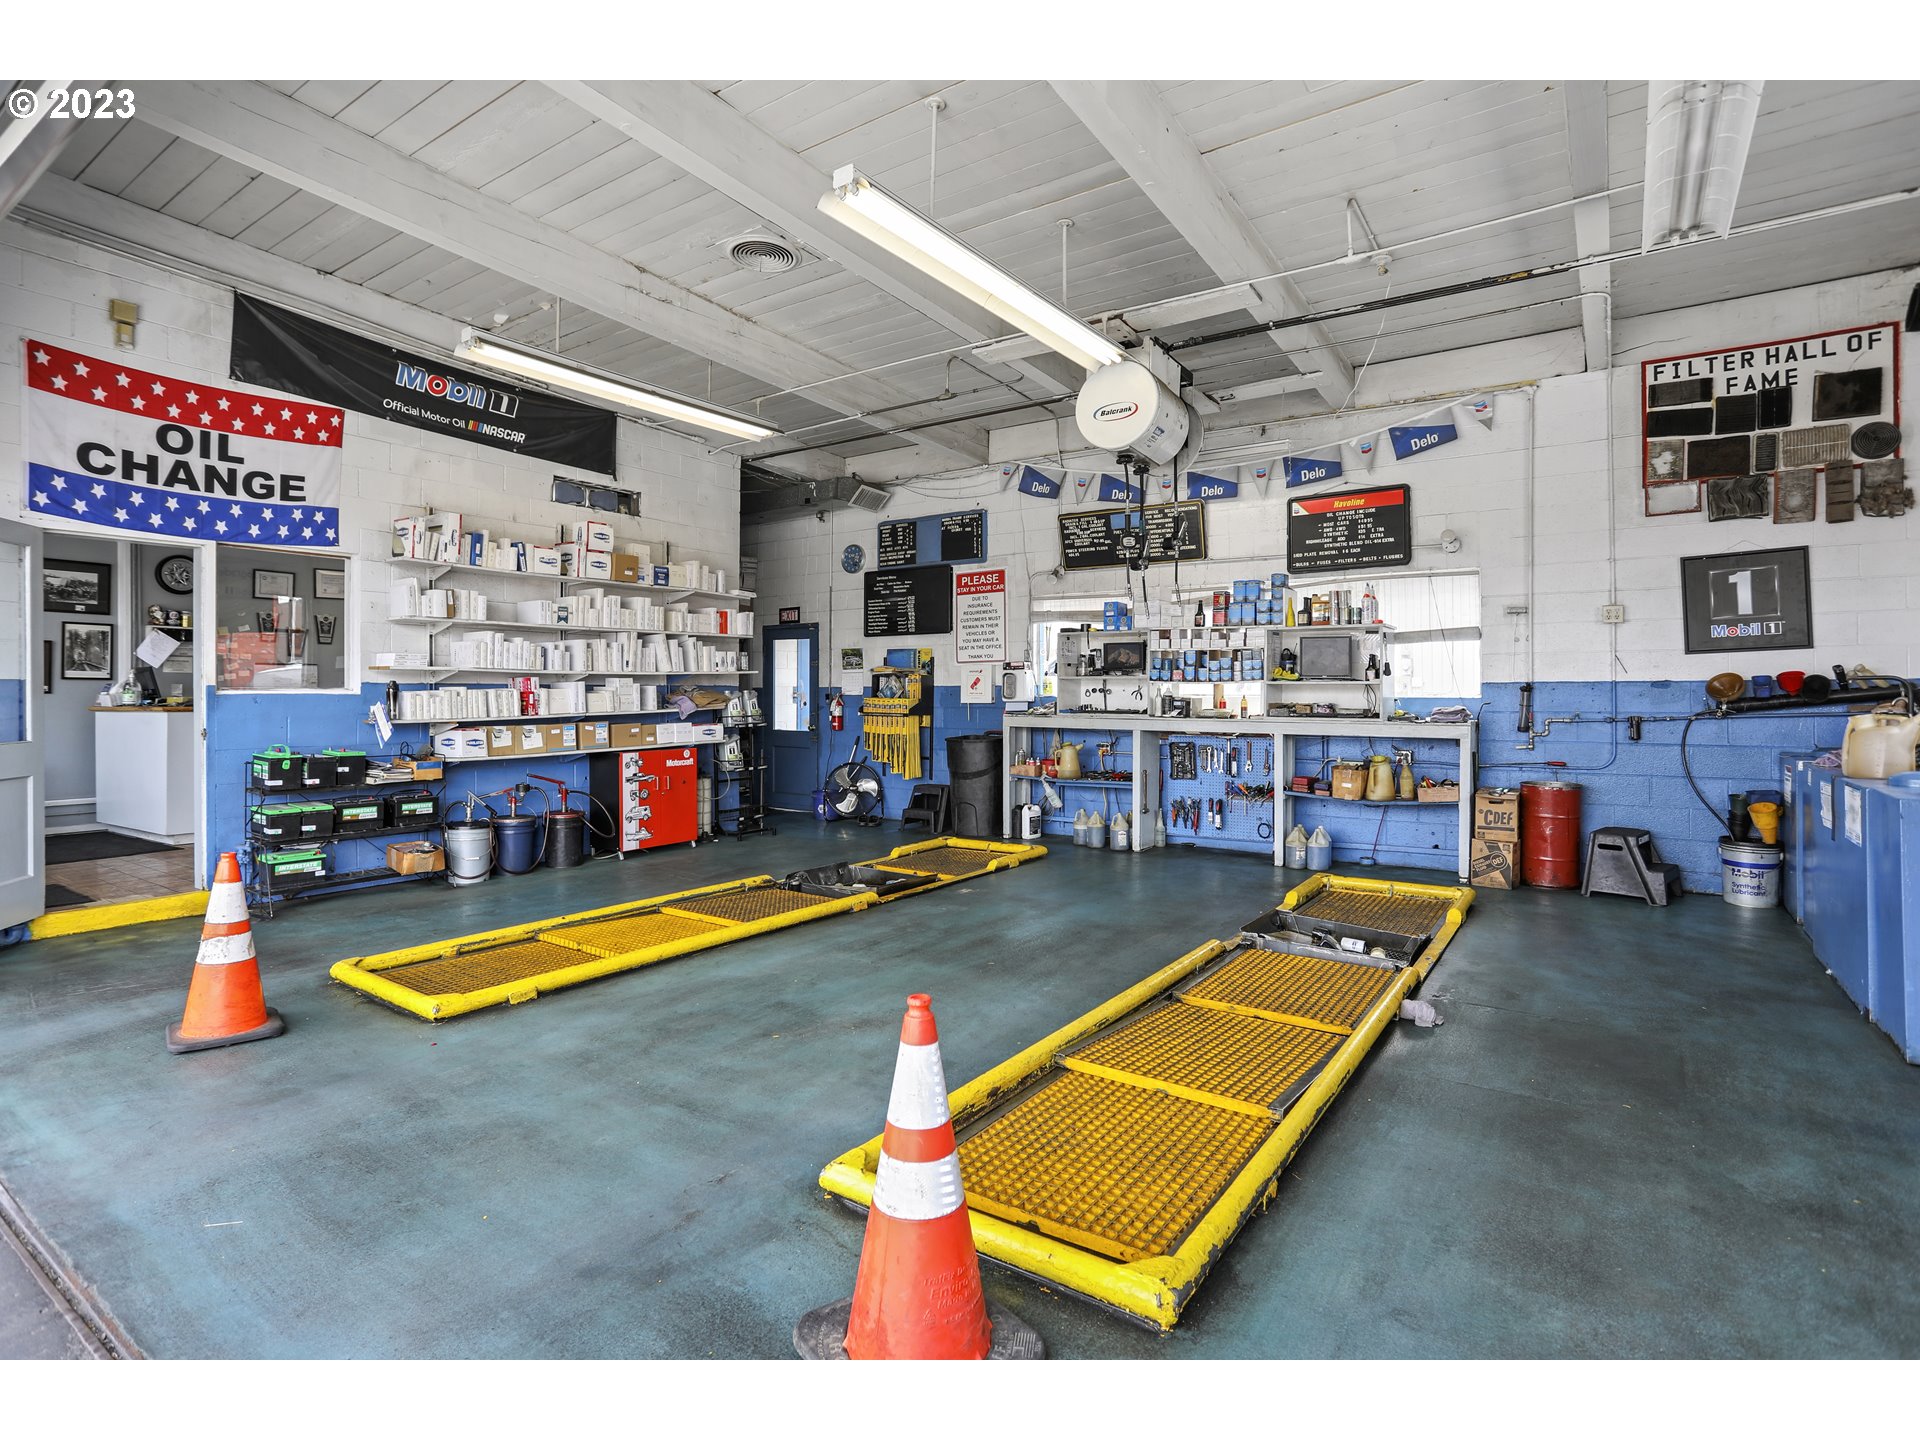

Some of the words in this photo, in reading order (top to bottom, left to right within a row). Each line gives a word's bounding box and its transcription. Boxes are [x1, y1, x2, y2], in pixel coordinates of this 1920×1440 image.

[1653, 350, 1756, 382] FILTER
[1765, 339, 1836, 366] HALL
[1846, 330, 1882, 353] OF
[395, 361, 486, 409] Mobil
[1726, 367, 1798, 395] FAME
[1100, 405, 1133, 417] Balcrank
[383, 398, 419, 417] Official
[421, 409, 451, 425] Motor
[452, 418, 466, 429] Oil
[482, 423, 526, 444] NASCAR
[155, 423, 245, 465] OIL
[1410, 433, 1439, 451] Delo
[76, 441, 307, 502] CHANGE
[1301, 467, 1326, 482] Delo
[1031, 482, 1050, 494] Delo
[1201, 485, 1223, 497] Delo
[1333, 498, 1365, 509] Havoline
[961, 574, 999, 585] PLEASE
[1728, 570, 1753, 615] 1
[780, 610, 798, 621] EXIT
[1710, 622, 1761, 638] Mobil
[666, 758, 694, 767] Motorcraft
[343, 806, 377, 815] INTERSTATE
[279, 860, 317, 871] INTERSTATE
[1492, 856, 1504, 866] DEF
[1731, 867, 1765, 879] Mobil
[1731, 881, 1766, 891] Synthetic
